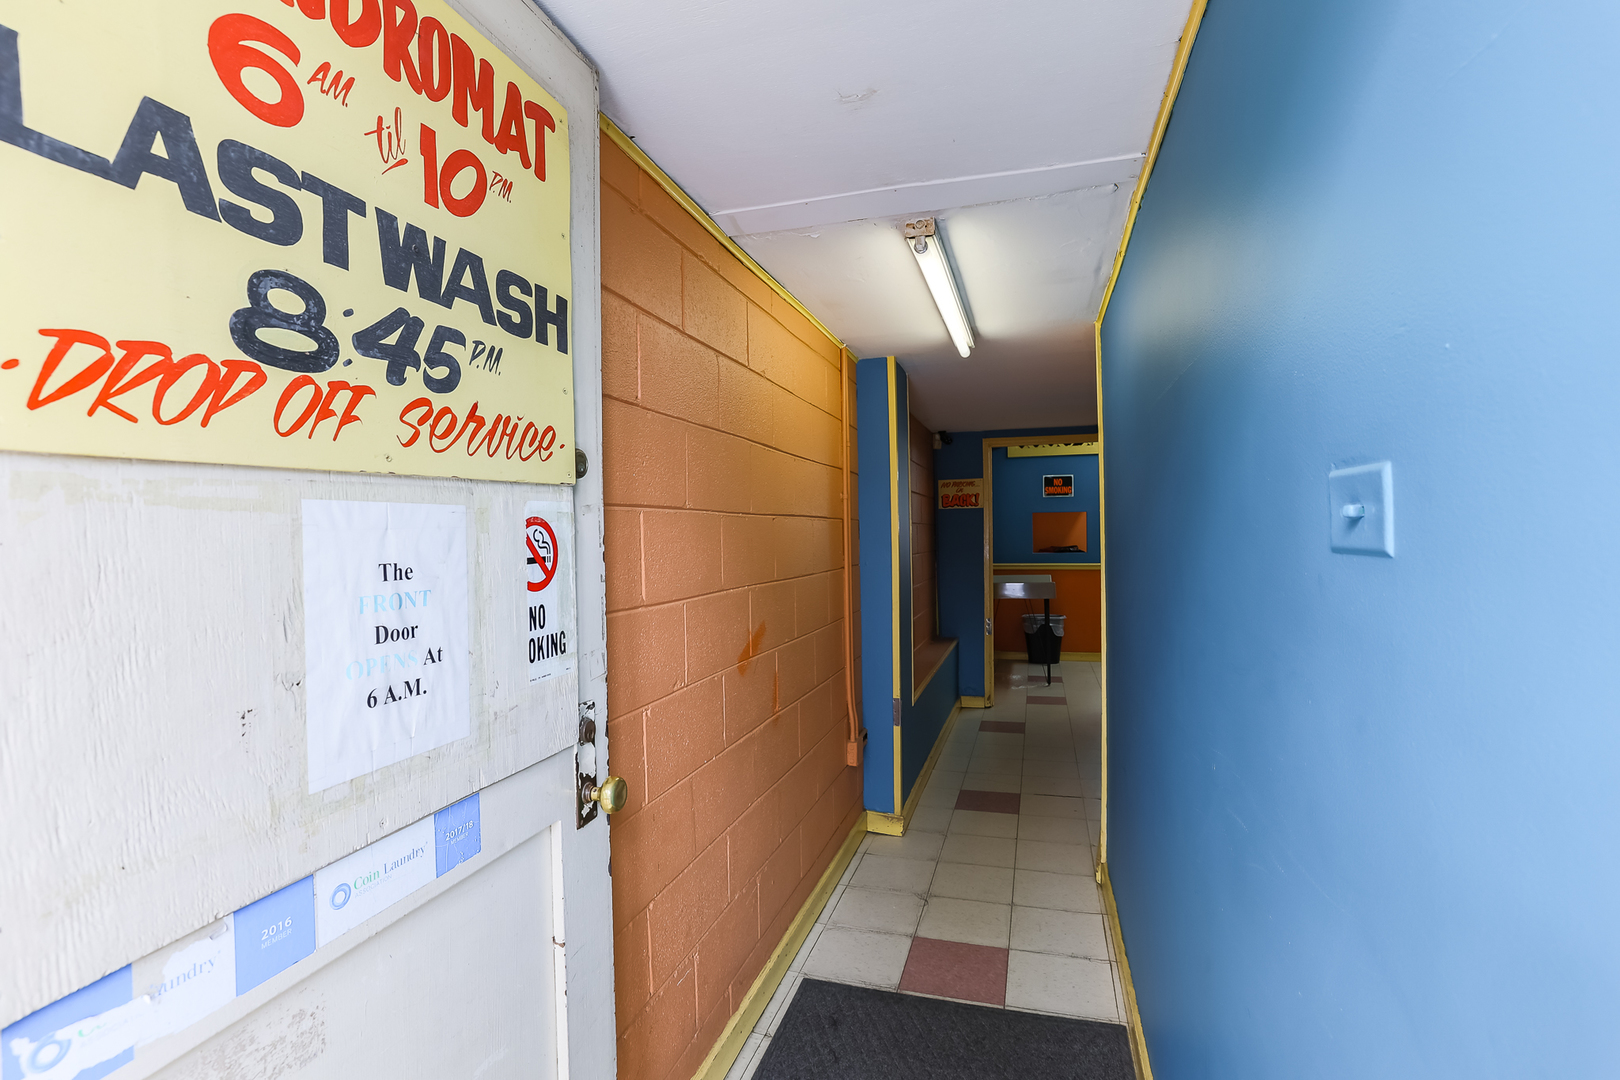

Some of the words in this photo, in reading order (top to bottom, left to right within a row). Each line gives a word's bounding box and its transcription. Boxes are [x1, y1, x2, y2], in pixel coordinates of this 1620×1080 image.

[207, 13, 304, 128] 6
[420, 122, 487, 217] 10
[0, 24, 366, 271] LAST
[375, 206, 568, 355] WASH
[229, 269, 466, 394] 8:45
[26, 328, 268, 428] DROP
[273, 375, 376, 442] OFF
[1045, 486, 1072, 494] SMOKING
[1053, 478, 1063, 486] NO
[941, 492, 980, 508] BACK!
[379, 563, 414, 582] The
[359, 589, 432, 615] FRONT
[529, 604, 546, 632] NO
[375, 624, 419, 645] Door
[345, 650, 418, 680] OPENS
[423, 647, 443, 666] At
[366, 688, 378, 709] 6
[383, 678, 427, 706] A.M.
[445, 820, 474, 841] 2017/18
[450, 831, 469, 846] MEMBER
[353, 870, 380, 890] Coin
[383, 846, 426, 874] Laundry
[355, 874, 393, 898] ASSOCIATION
[261, 916, 293, 941] 2016
[261, 928, 292, 950] MEMBER
